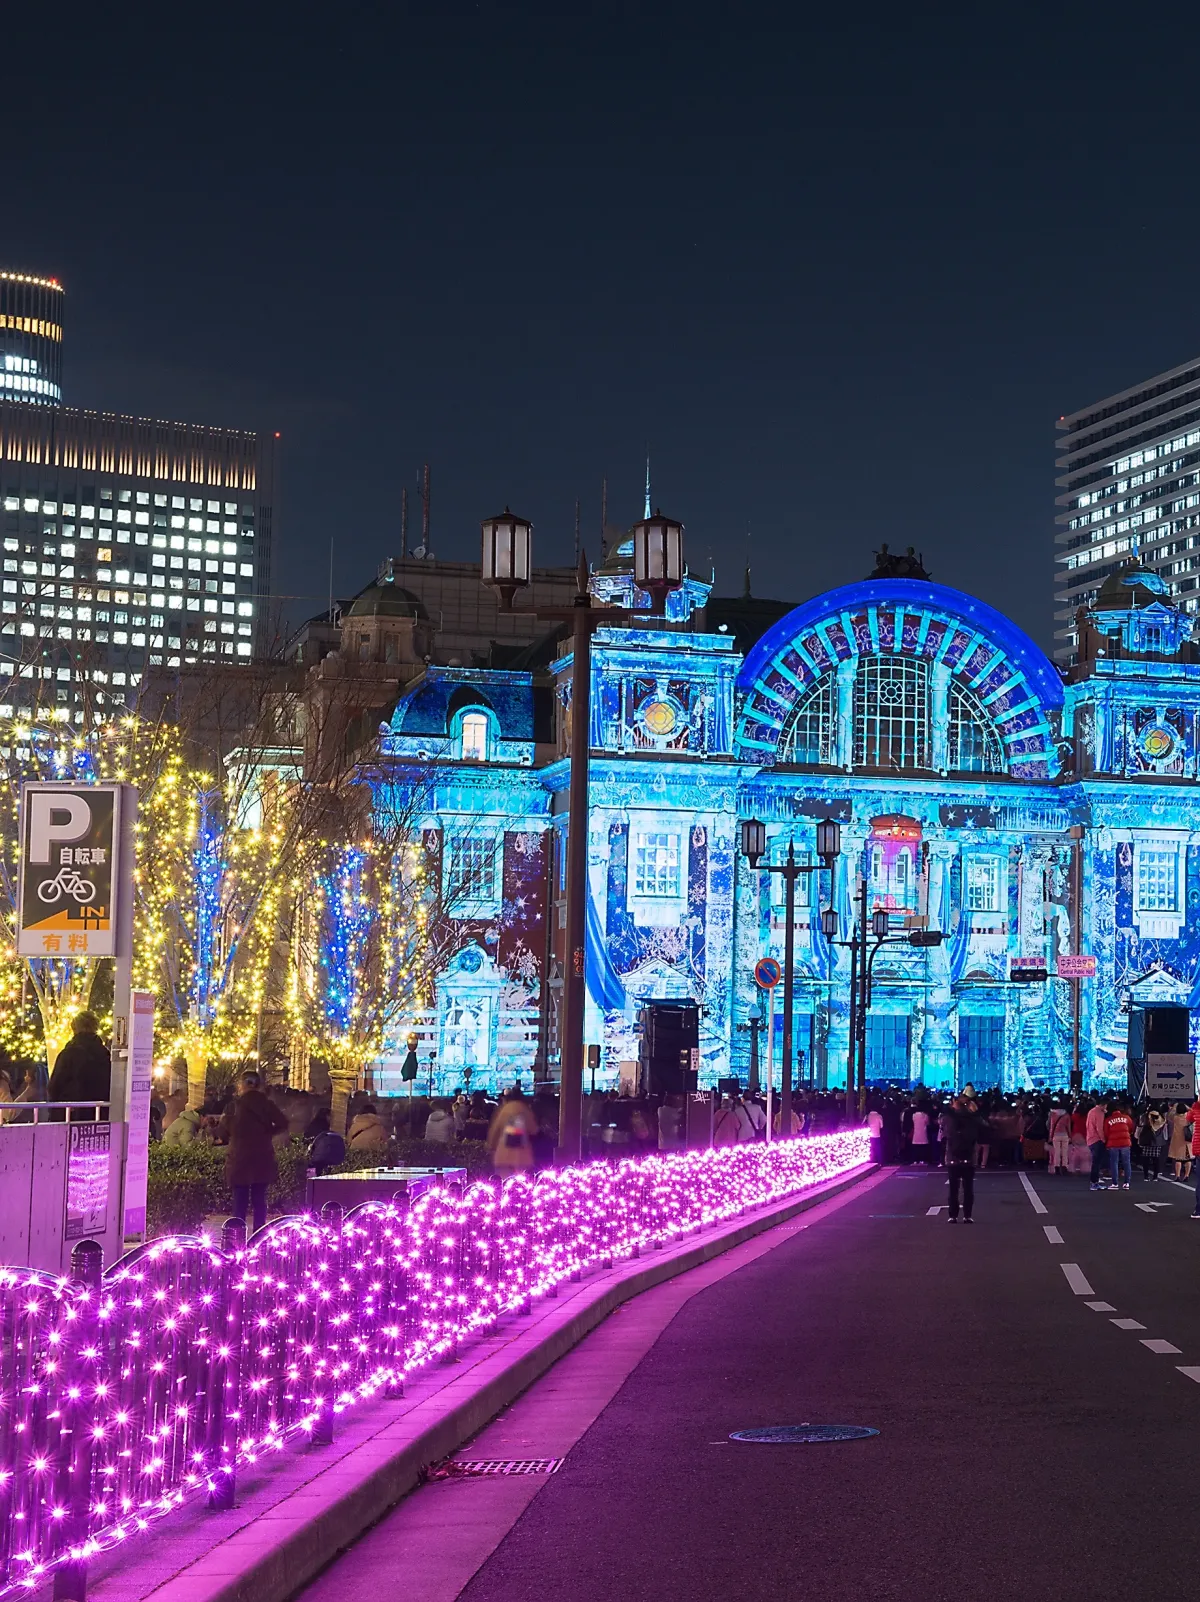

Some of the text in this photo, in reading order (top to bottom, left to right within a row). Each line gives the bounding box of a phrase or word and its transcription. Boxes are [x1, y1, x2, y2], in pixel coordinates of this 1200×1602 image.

[30, 793, 91, 863] P
[60, 847, 106, 865] 自転車
[80, 906, 105, 918] IN
[42, 933, 89, 952] 有料
